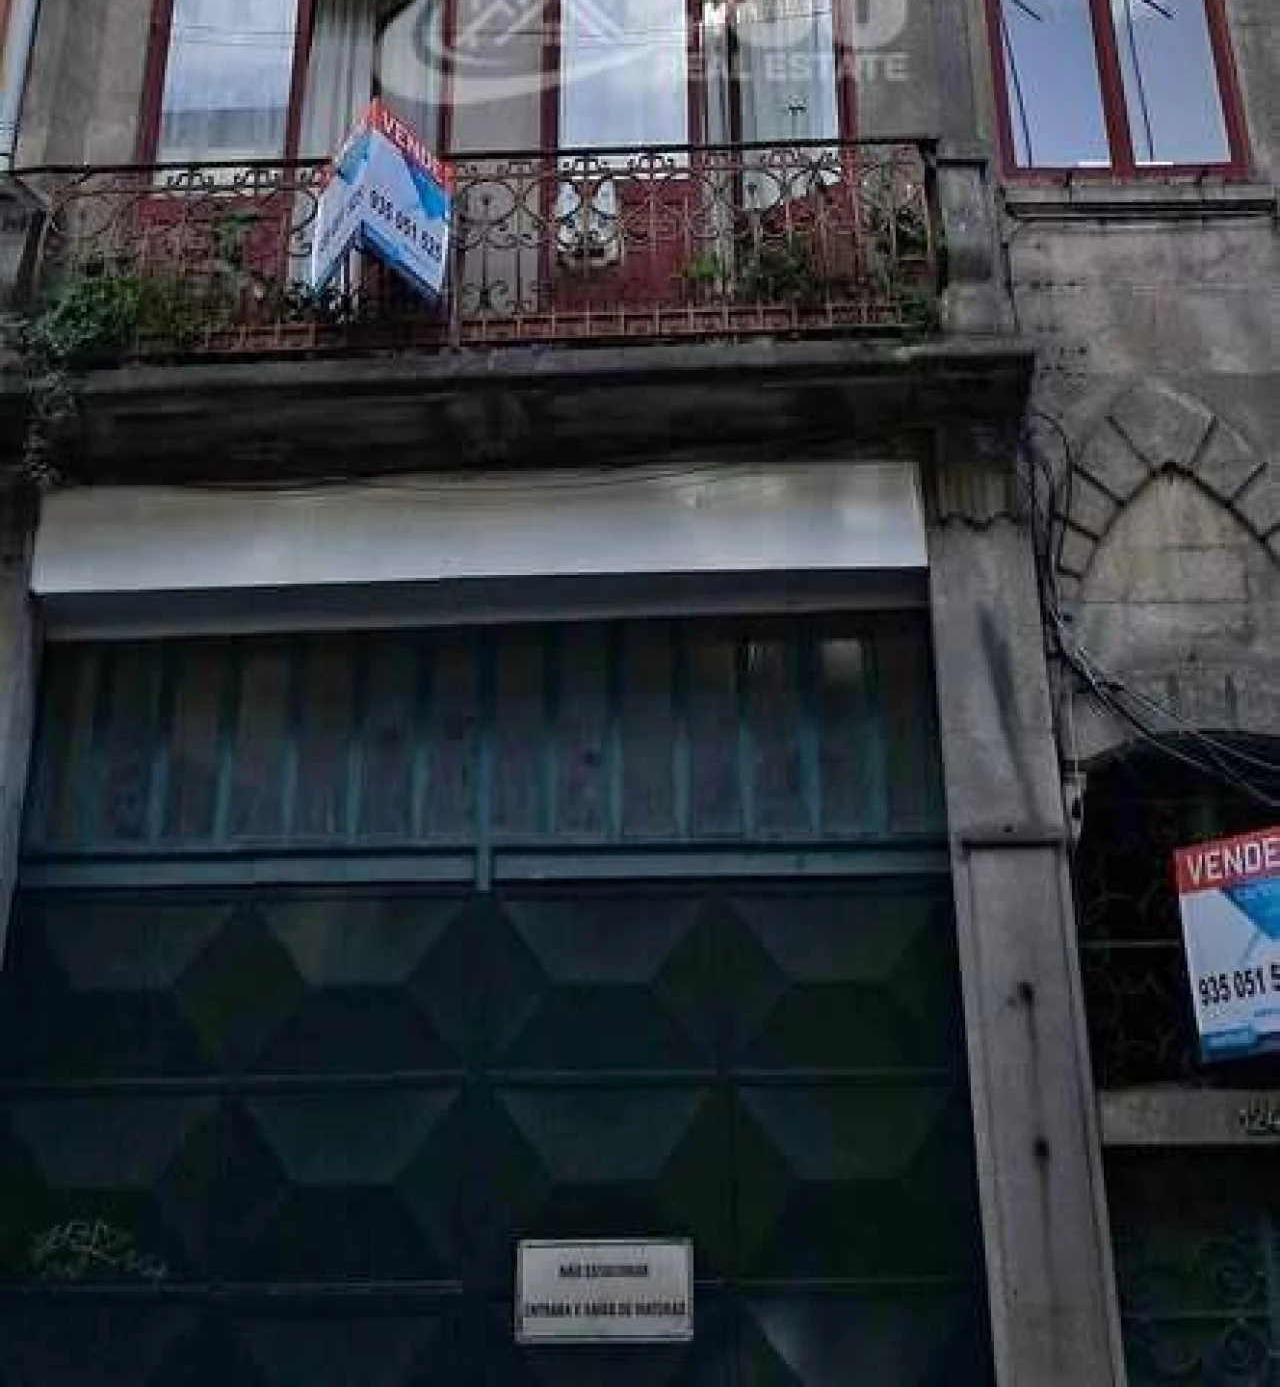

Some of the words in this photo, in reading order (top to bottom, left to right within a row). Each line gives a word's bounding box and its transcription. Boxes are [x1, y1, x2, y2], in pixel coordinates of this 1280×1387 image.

[1186, 836, 1280, 885] VENDE
[1199, 972, 1231, 1006] 935
[1233, 966, 1266, 999] 051
